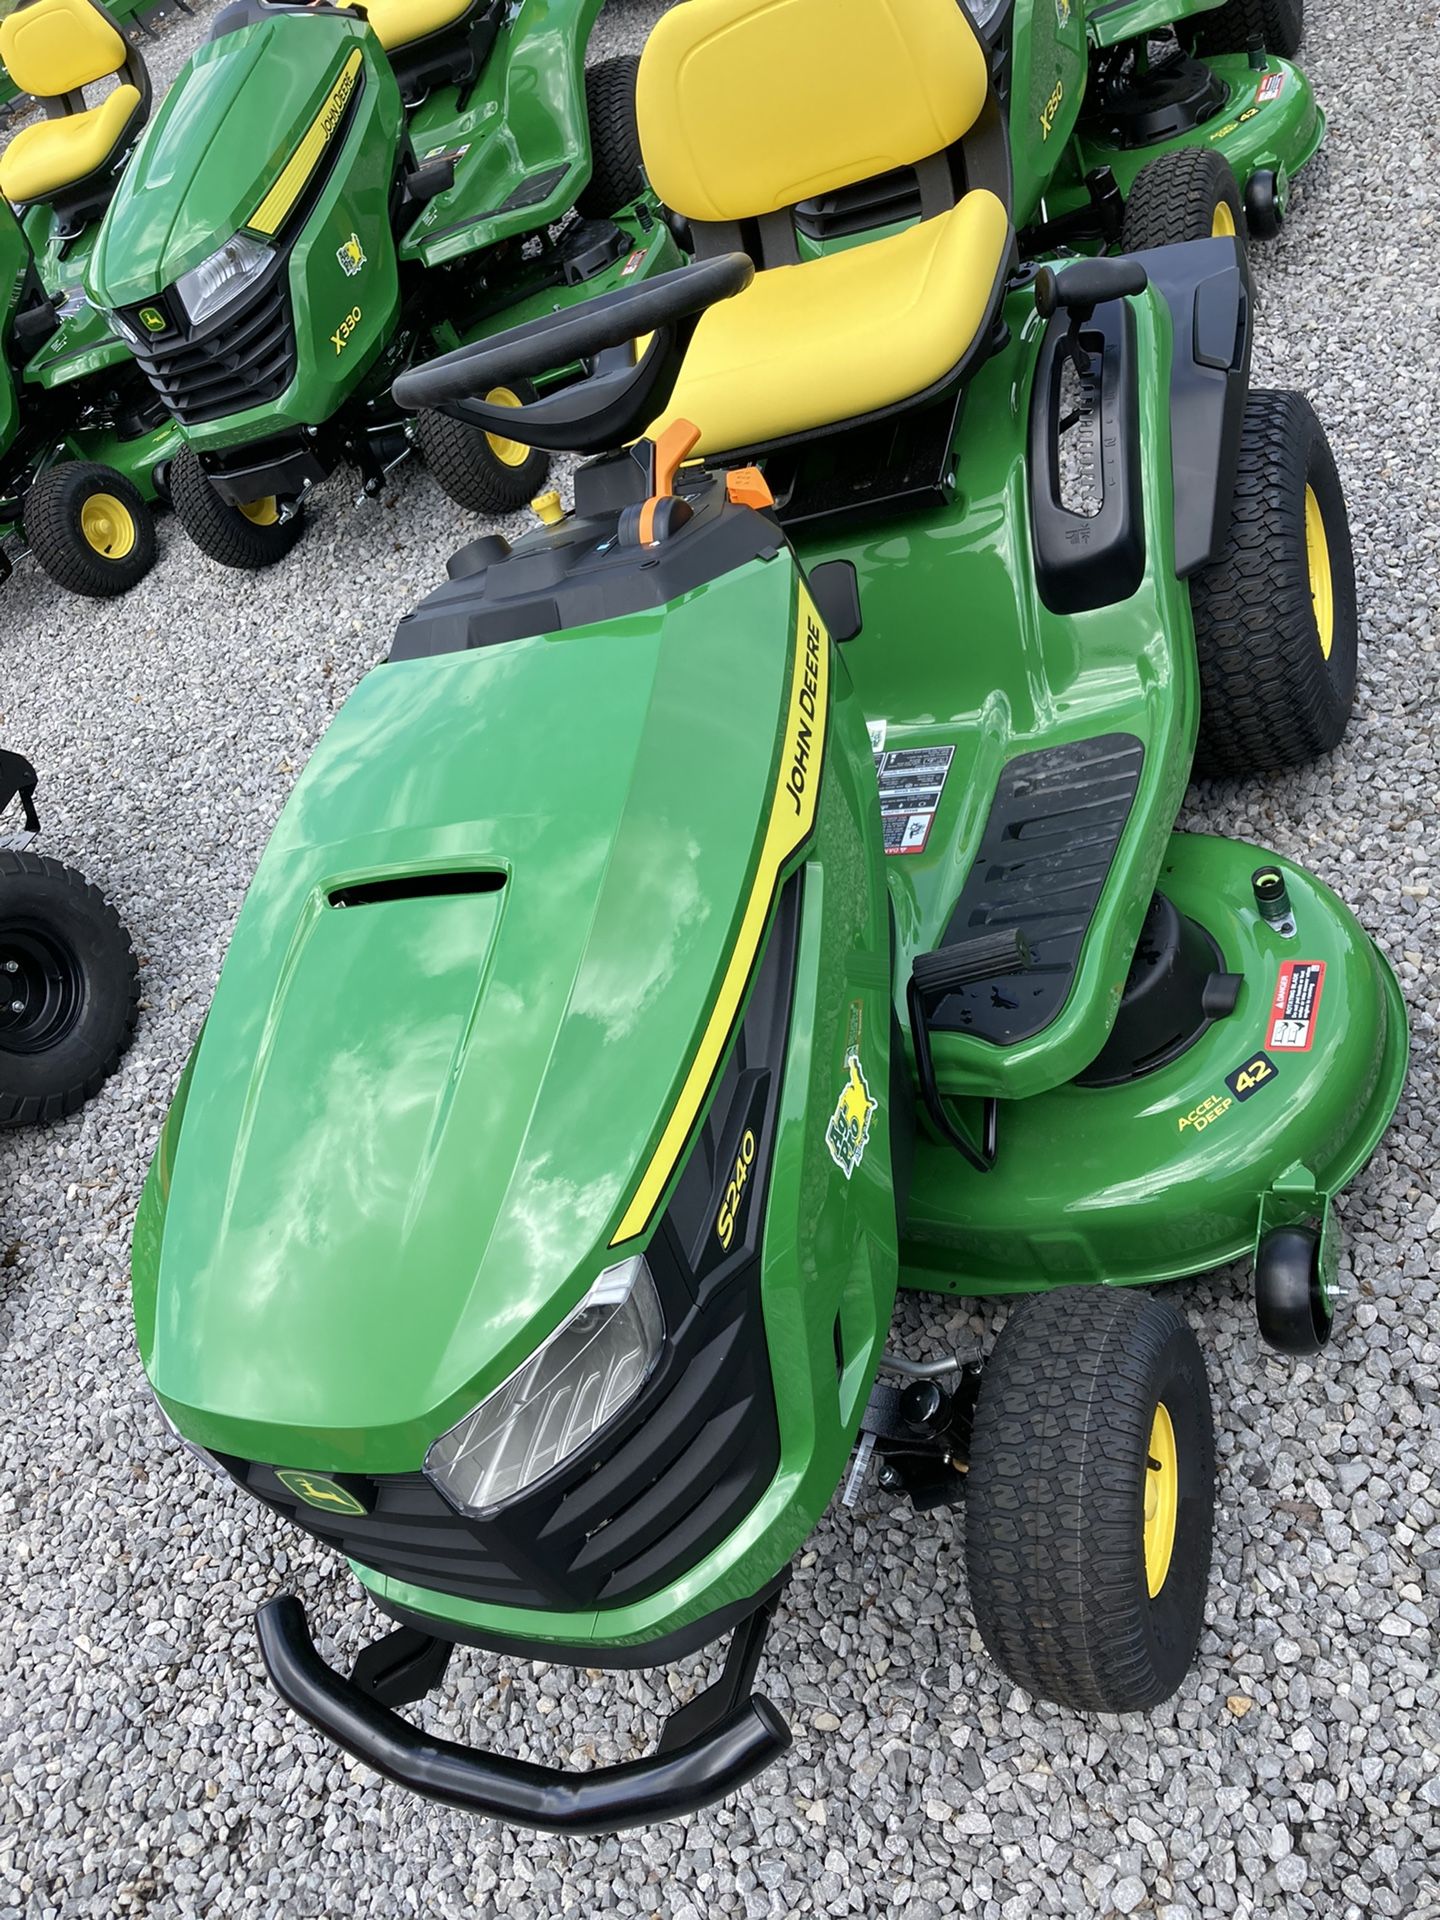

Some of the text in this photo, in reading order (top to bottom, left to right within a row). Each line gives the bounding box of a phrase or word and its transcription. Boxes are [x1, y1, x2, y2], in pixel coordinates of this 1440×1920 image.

[321, 71, 354, 139] JOHN DEERE
[1040, 80, 1063, 142] X350
[1240, 107, 1259, 122] 42
[330, 306, 362, 355] X330
[786, 615, 820, 816] JOHN DEERE
[1276, 975, 1288, 1002] DANGER
[1236, 1060, 1272, 1093] 42
[1178, 1095, 1222, 1132] ACCEL
[1193, 1098, 1232, 1132] DEEP
[718, 1130, 755, 1249] S240
